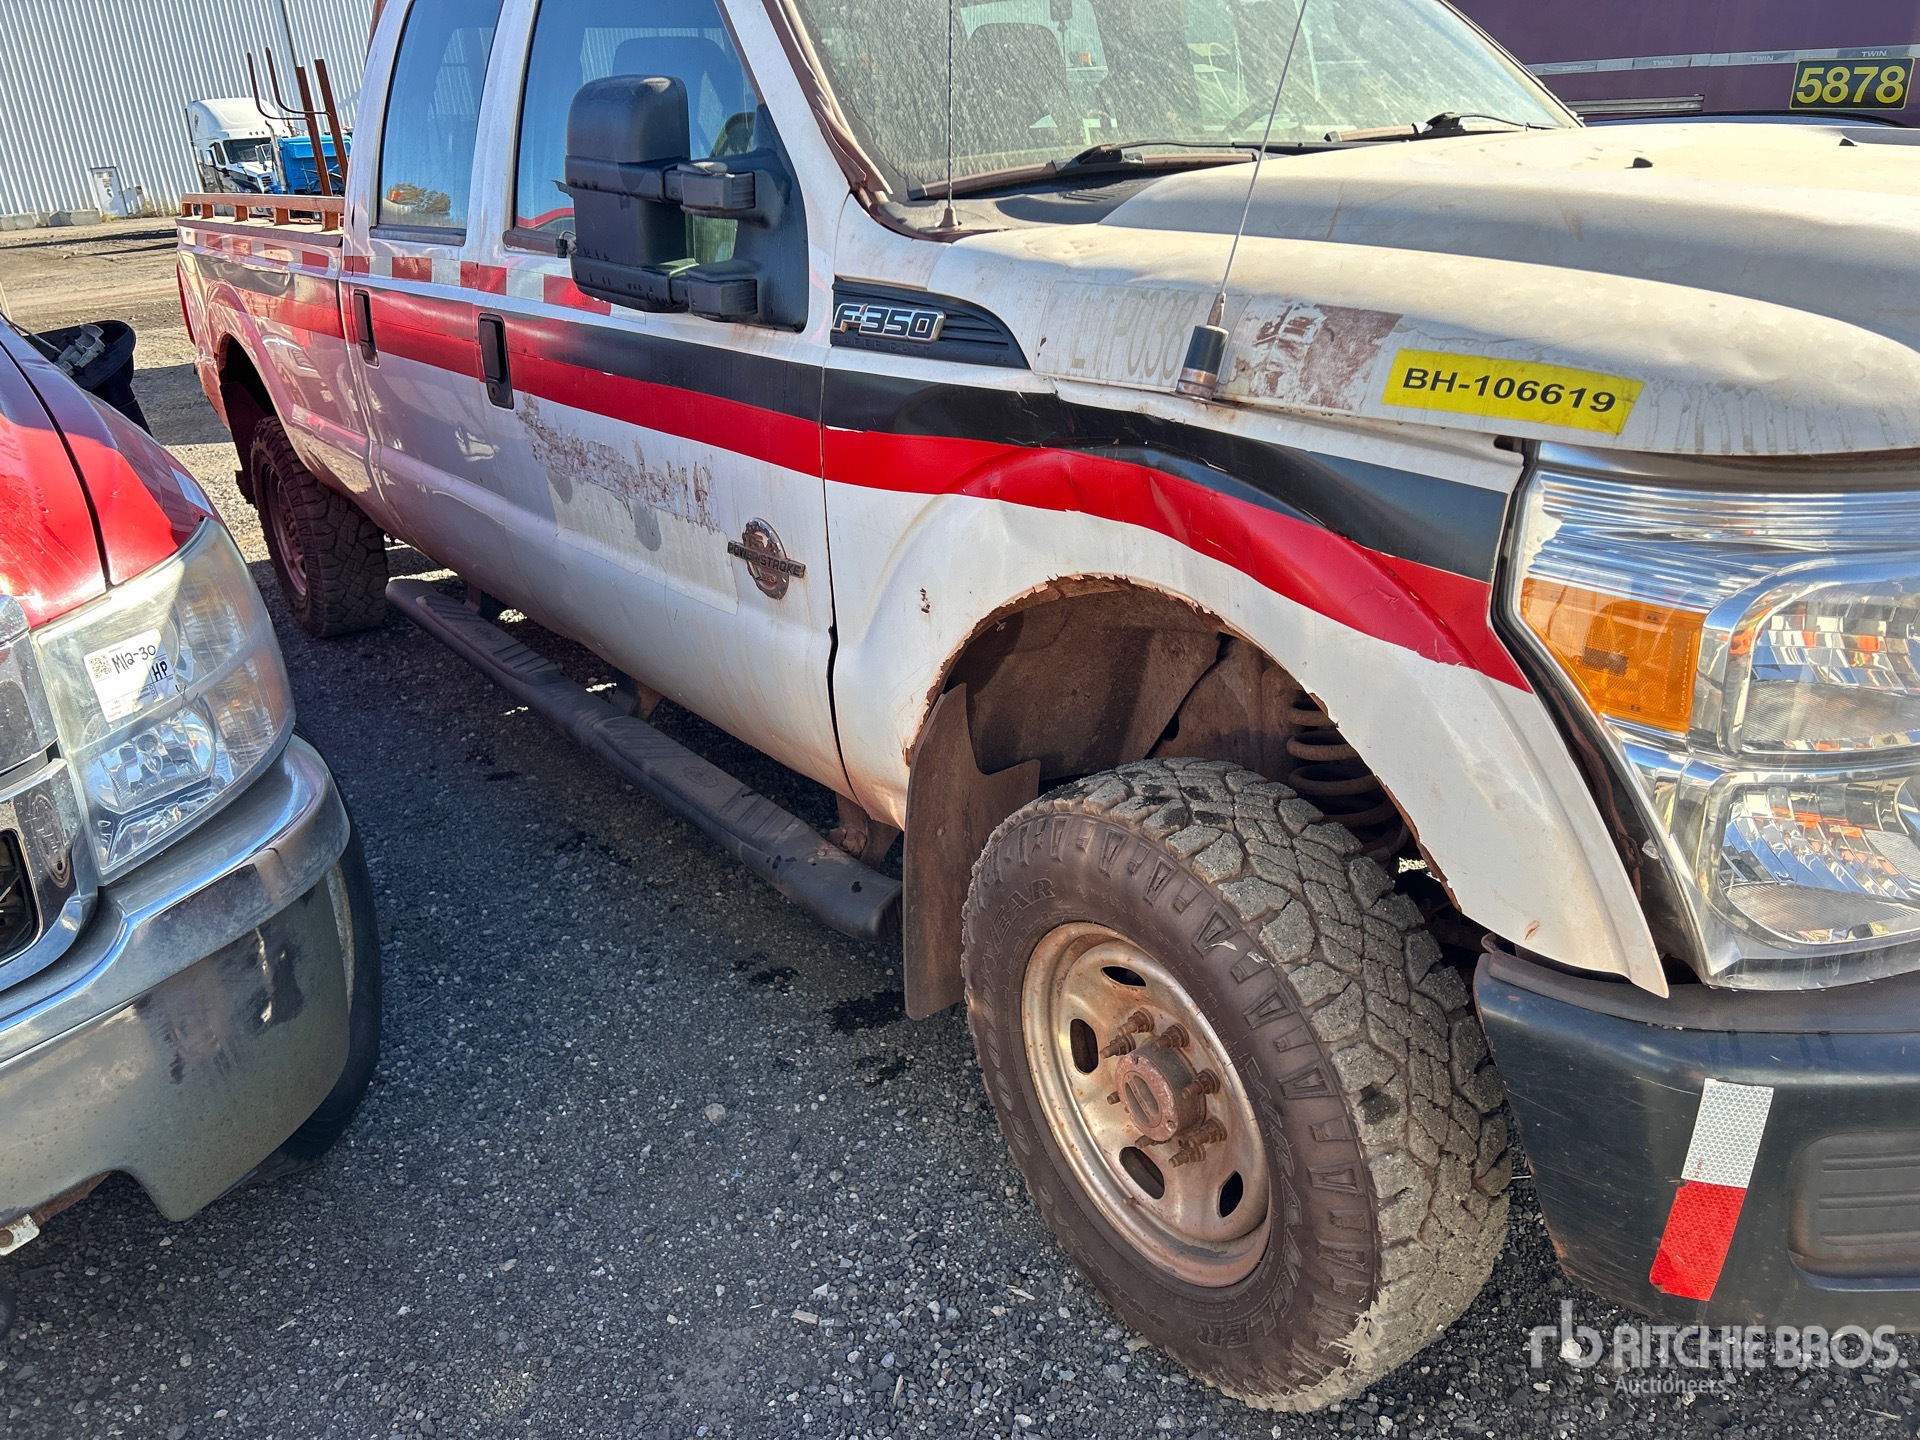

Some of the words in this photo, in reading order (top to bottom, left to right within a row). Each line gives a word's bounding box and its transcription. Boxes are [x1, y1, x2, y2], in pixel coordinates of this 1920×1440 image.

[1796, 65, 1905, 104] 5878
[833, 303, 943, 343] F-350
[1402, 367, 1617, 413] BH-106619
[111, 645, 156, 674] M12-30
[152, 661, 168, 682] HP
